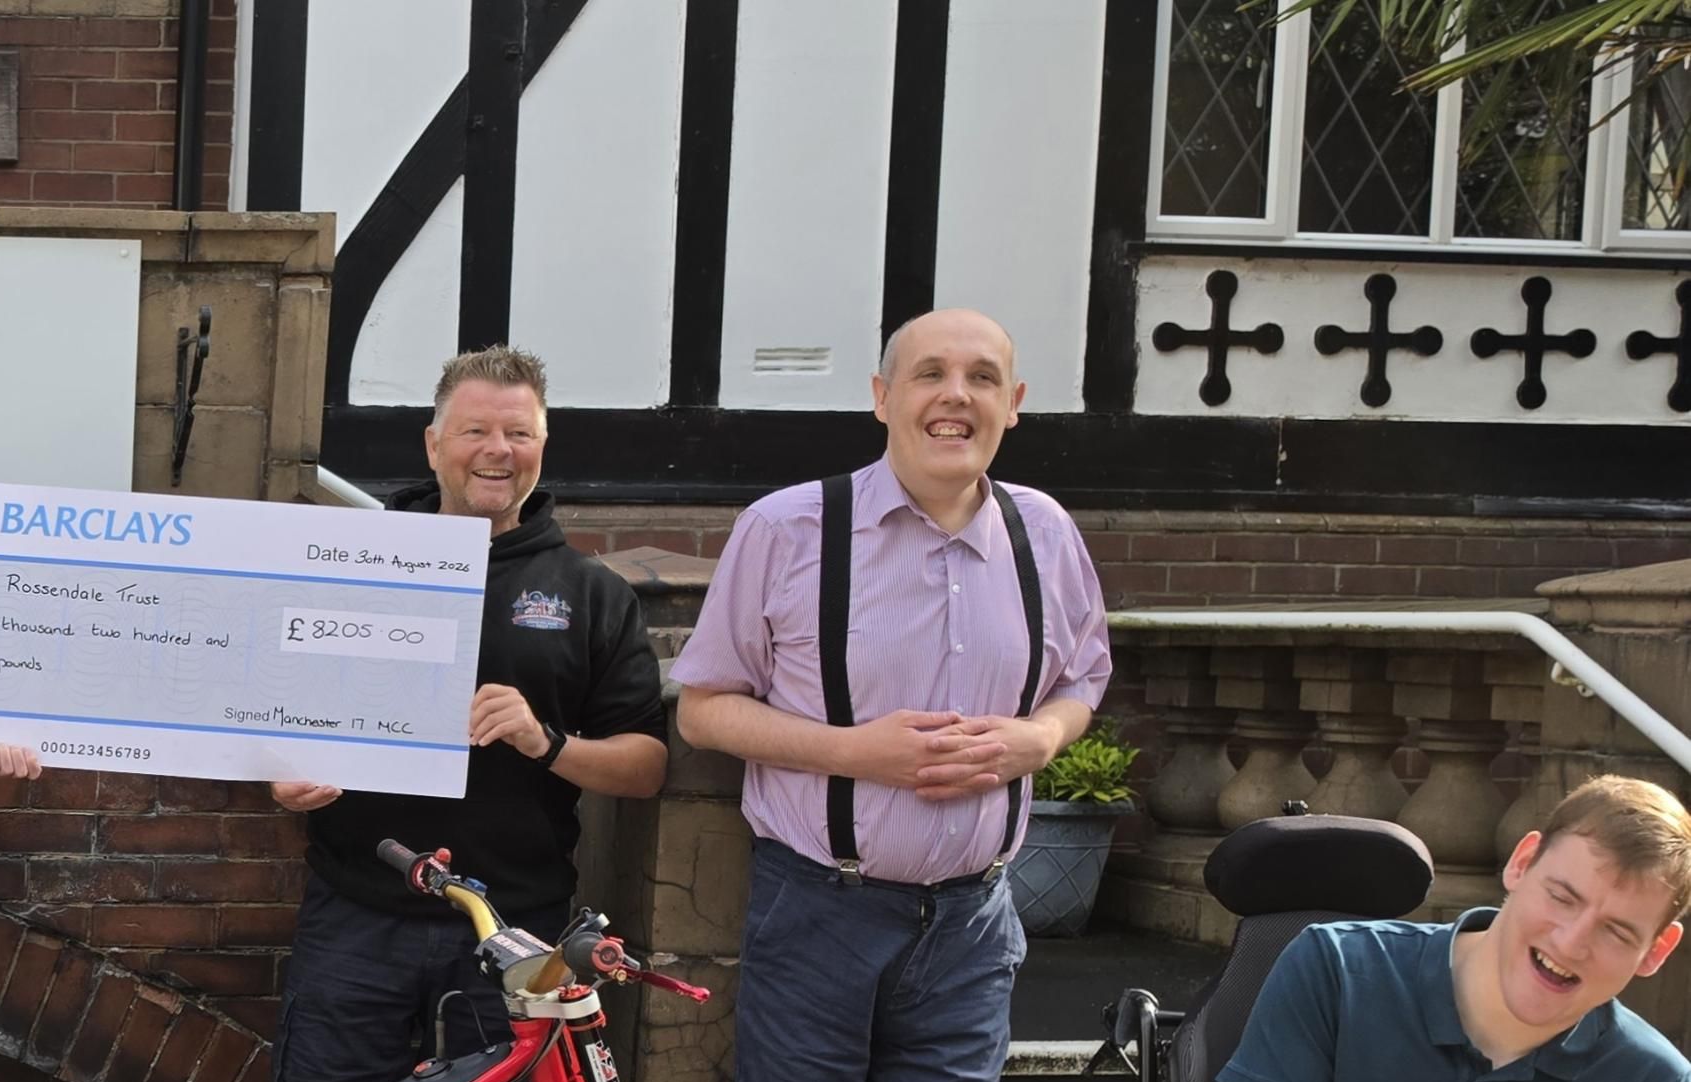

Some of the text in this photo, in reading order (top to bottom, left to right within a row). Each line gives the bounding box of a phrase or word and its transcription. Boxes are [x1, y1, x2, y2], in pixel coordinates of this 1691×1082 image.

[0, 502, 193, 546] BARCLAYS
[307, 544, 349, 562] Date
[355, 550, 385, 564] 30th
[392, 555, 431, 573] August
[7, 574, 105, 602] Rossendale
[116, 583, 160, 605] Trust
[2, 616, 75, 636] thousand
[92, 623, 121, 639] two
[133, 623, 191, 646] hundred
[206, 634, 230, 648] and
[224, 706, 414, 734] Signed Manchester 17 MCC
[40, 741, 151, 760] 000123456789
